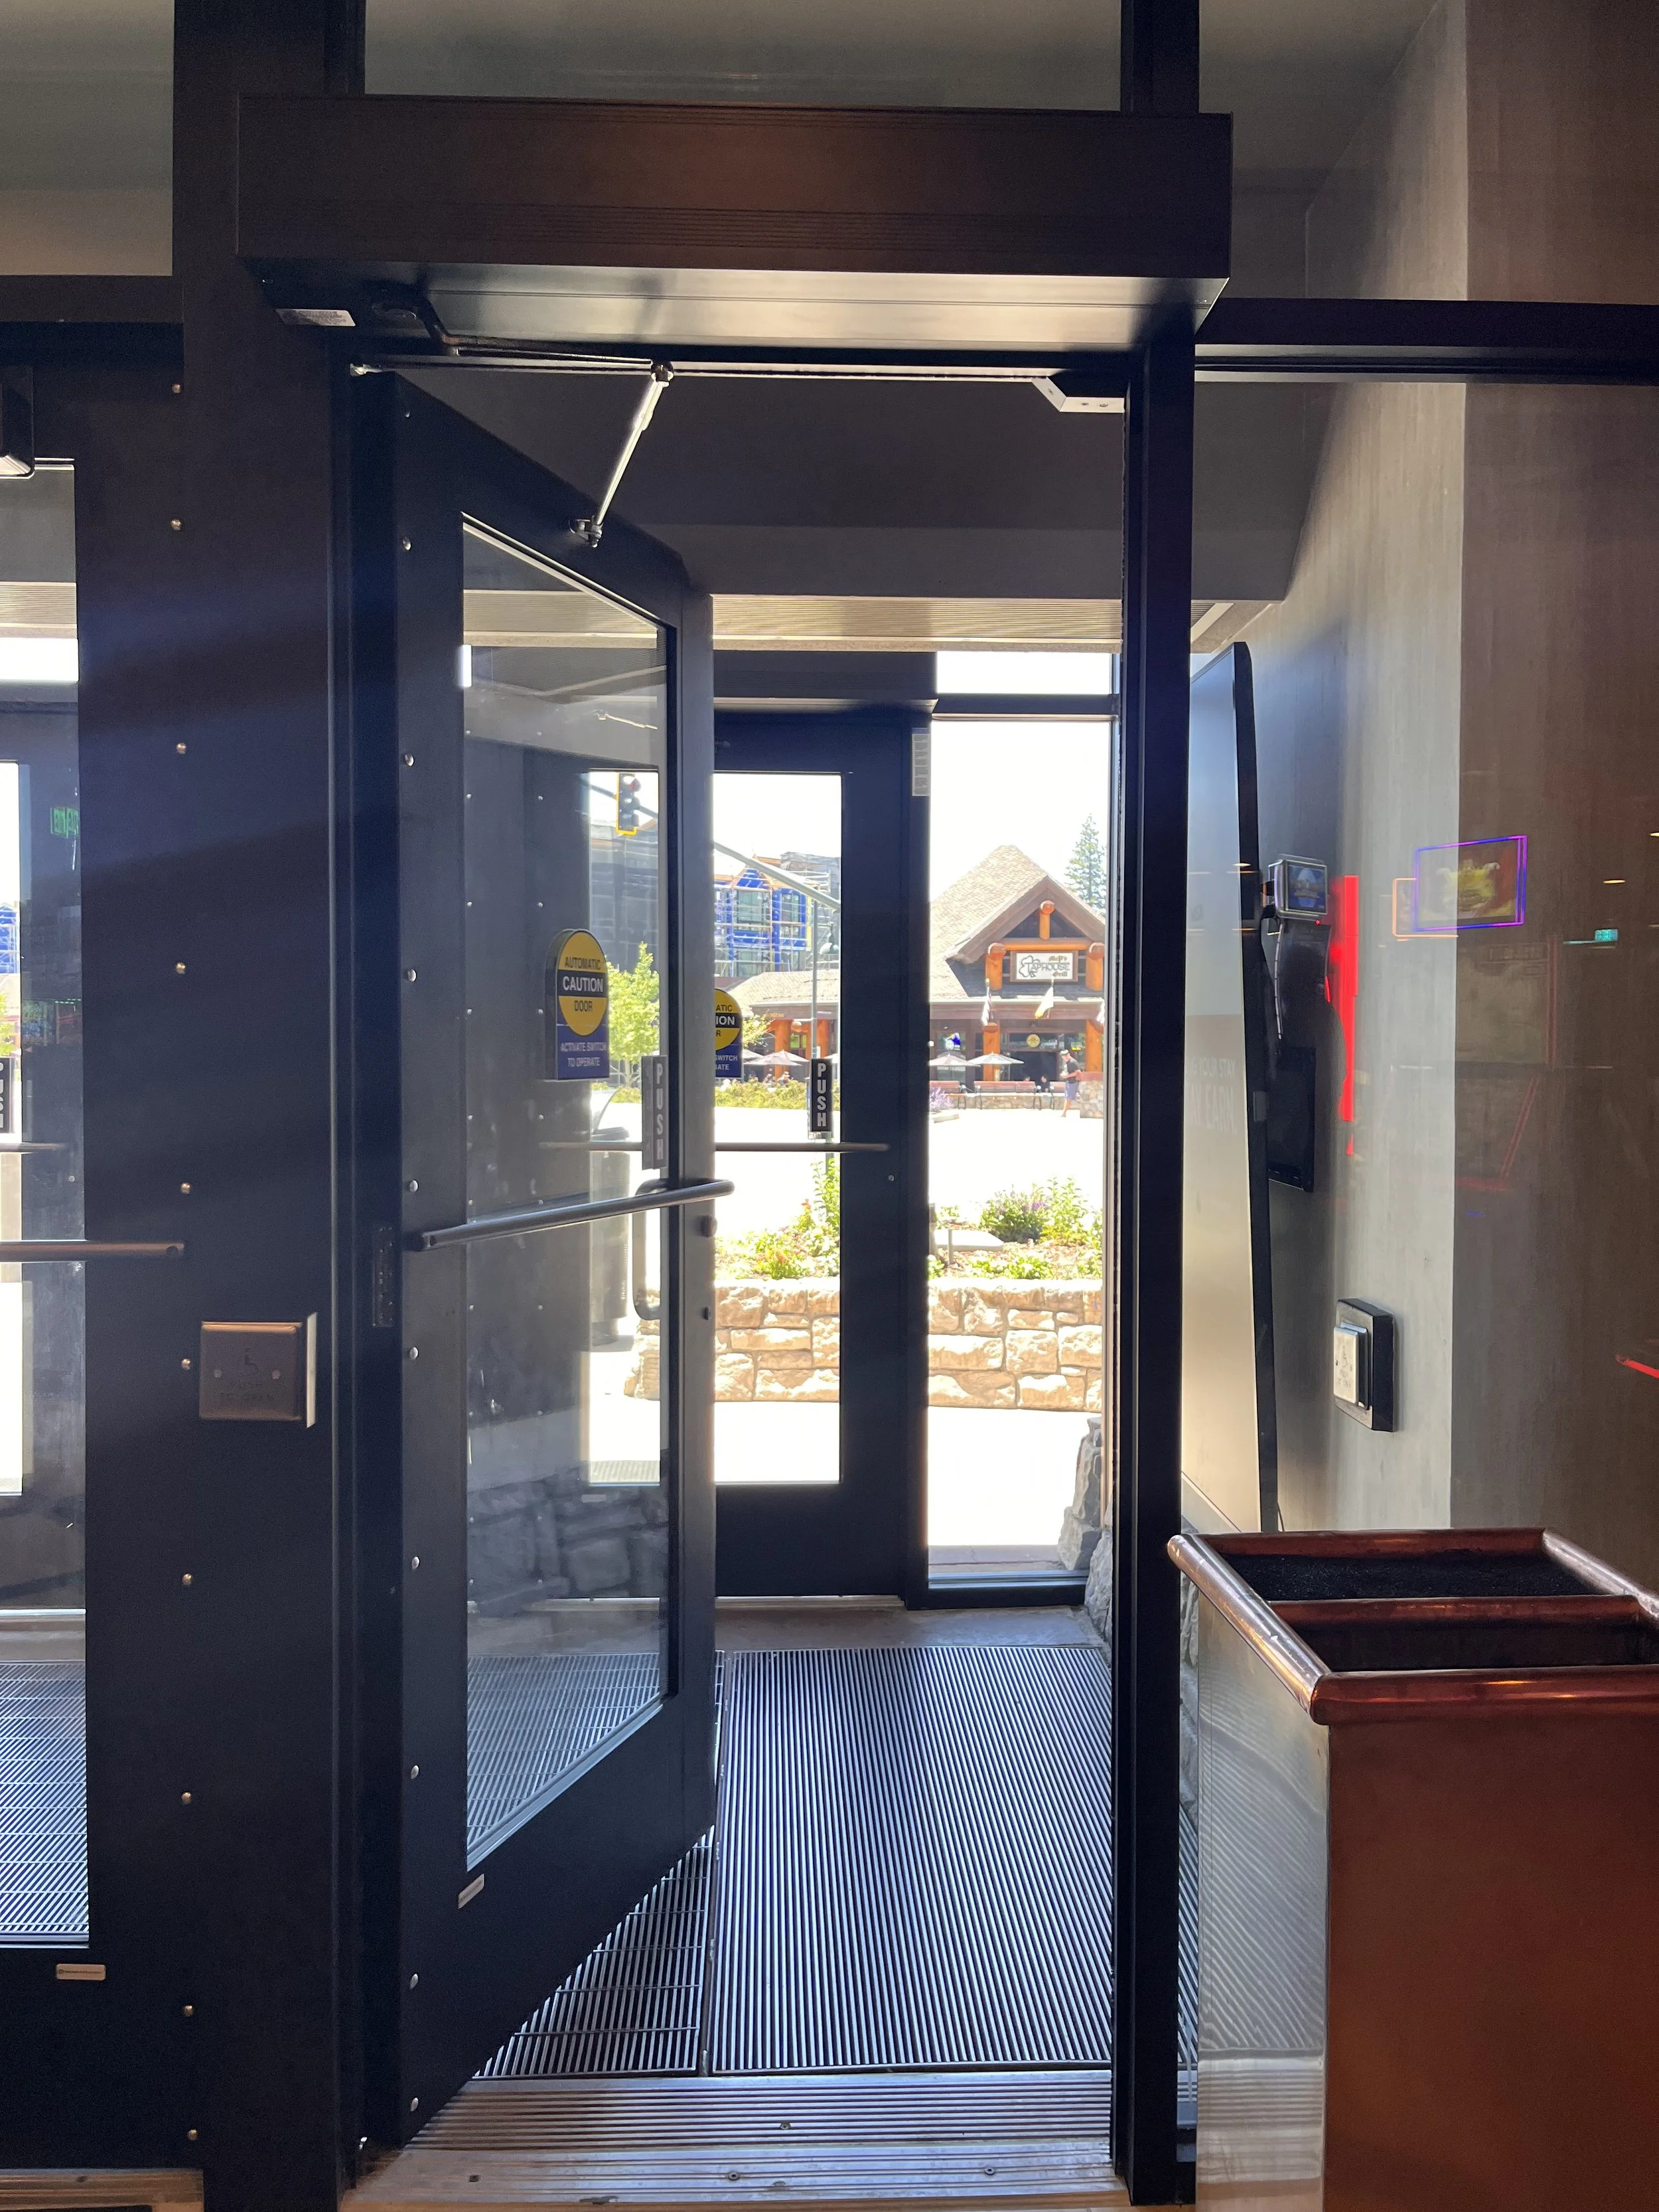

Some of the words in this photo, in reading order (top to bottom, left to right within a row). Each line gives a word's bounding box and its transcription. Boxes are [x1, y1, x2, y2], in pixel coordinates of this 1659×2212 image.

[565, 956, 601, 970] AUTOMATIC
[1024, 962, 1070, 973] TAPHOUSE
[563, 976, 603, 992] CAUTION
[574, 999, 593, 1012] DOOR
[560, 1042, 586, 1051] ACTIVATE
[587, 1042, 607, 1051] SWITCH
[567, 1058, 575, 1067] TO
[576, 1057, 600, 1067] OPERATE
[817, 1063, 827, 1127] PUSH
